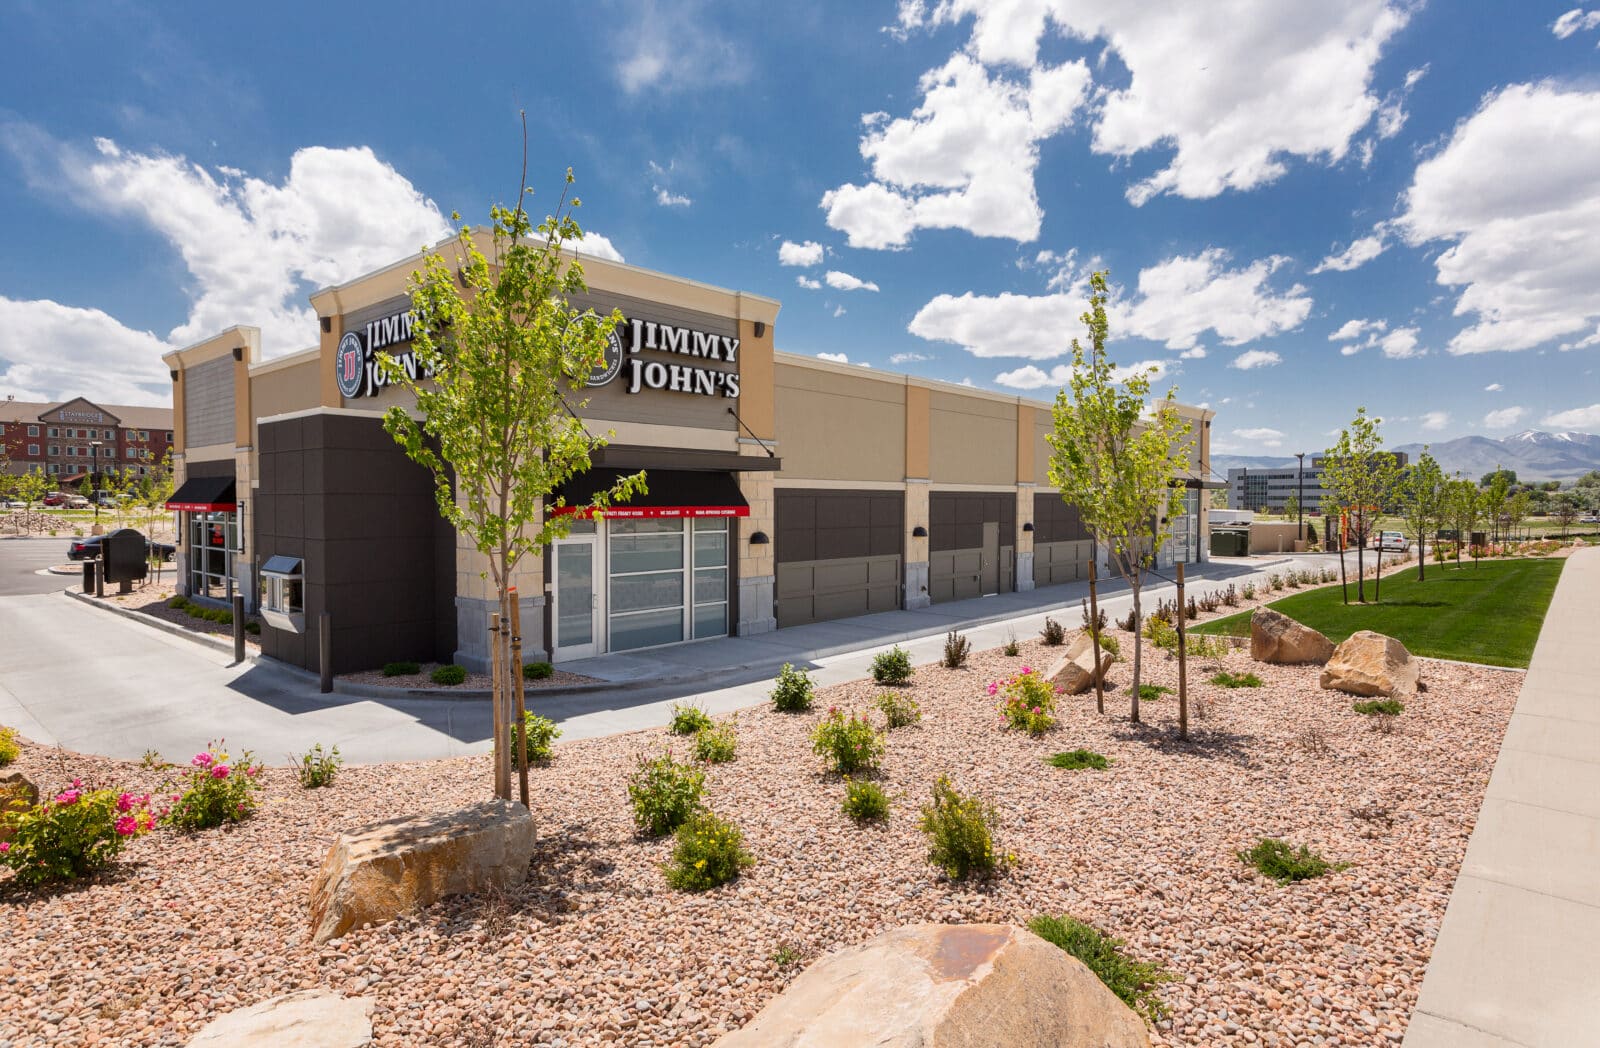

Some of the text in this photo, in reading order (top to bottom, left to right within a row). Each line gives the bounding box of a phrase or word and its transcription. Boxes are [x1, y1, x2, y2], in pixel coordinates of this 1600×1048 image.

[630, 318, 740, 362] JIMMY
[343, 350, 356, 382] JJ
[630, 359, 740, 399] JOHN'S
